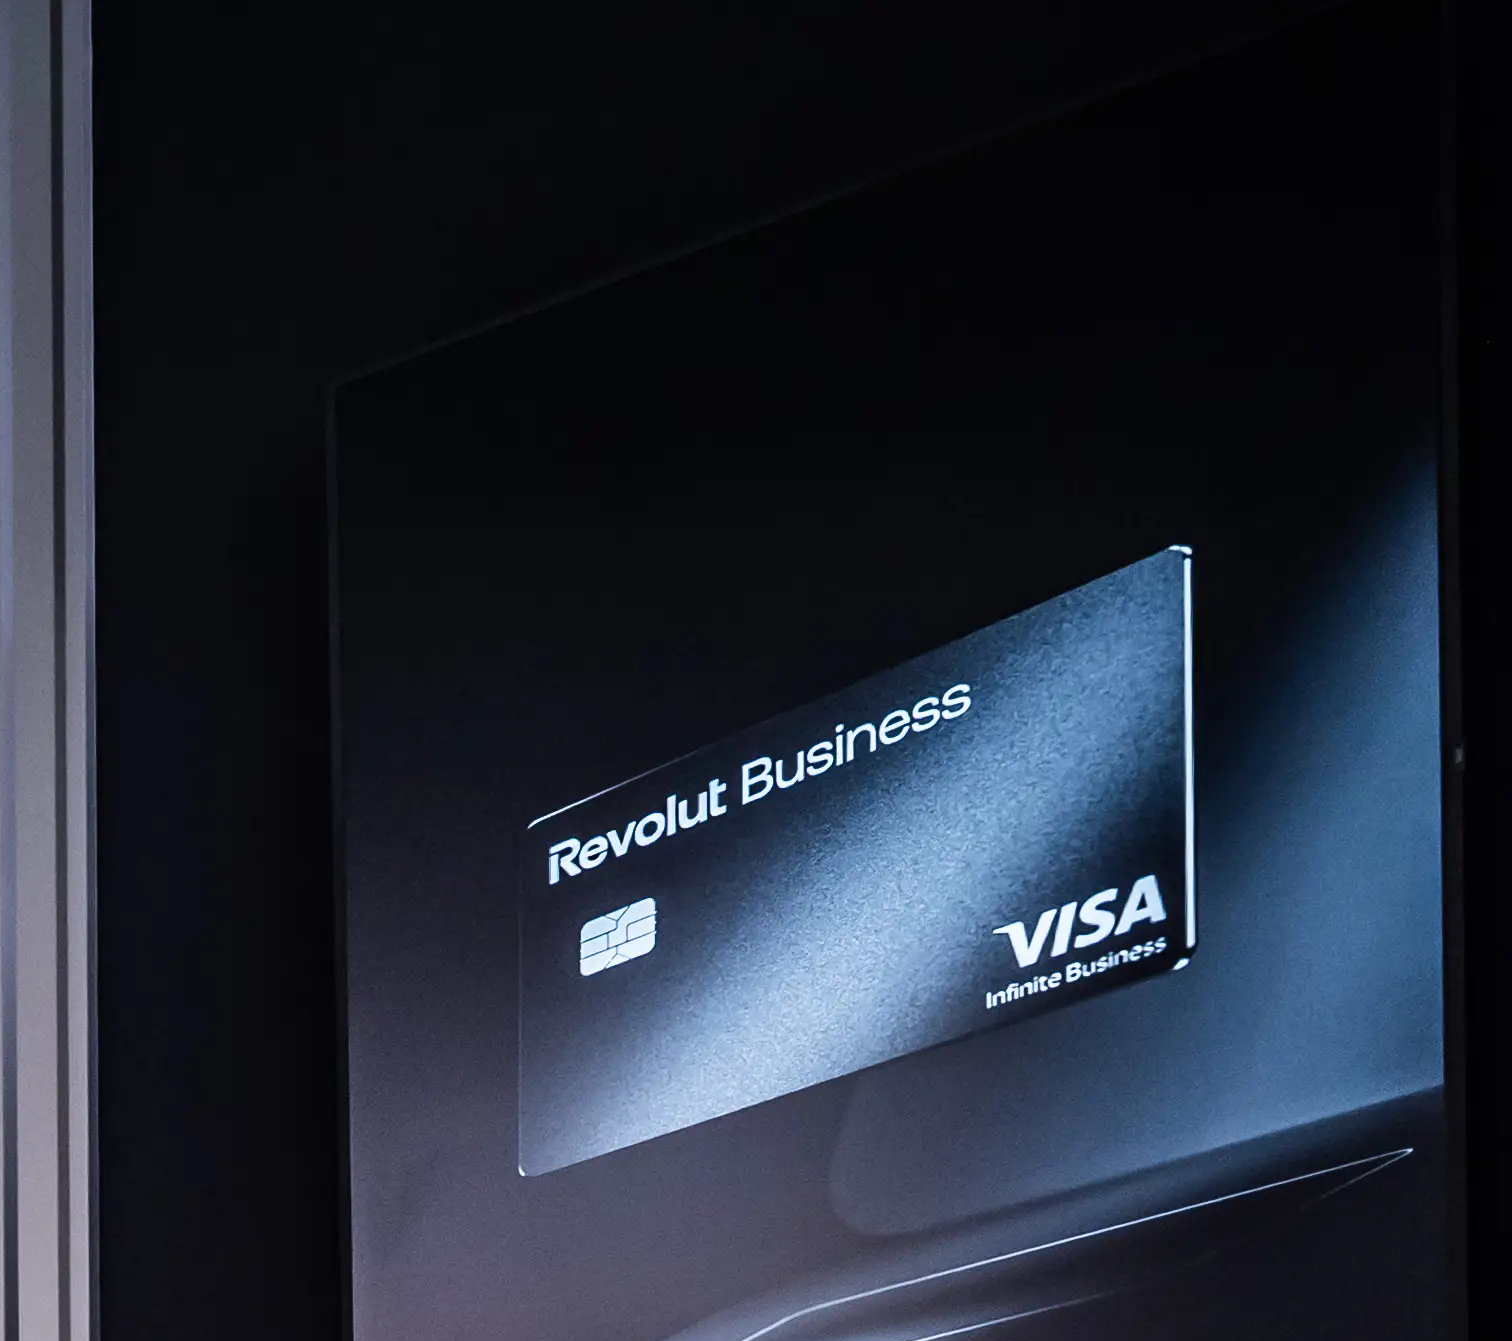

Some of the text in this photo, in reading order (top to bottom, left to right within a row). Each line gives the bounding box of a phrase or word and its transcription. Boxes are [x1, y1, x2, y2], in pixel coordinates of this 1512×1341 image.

[548, 683, 973, 885] Revolut Business
[992, 874, 1167, 968] VISA
[985, 937, 1167, 1009] Infinite Business
